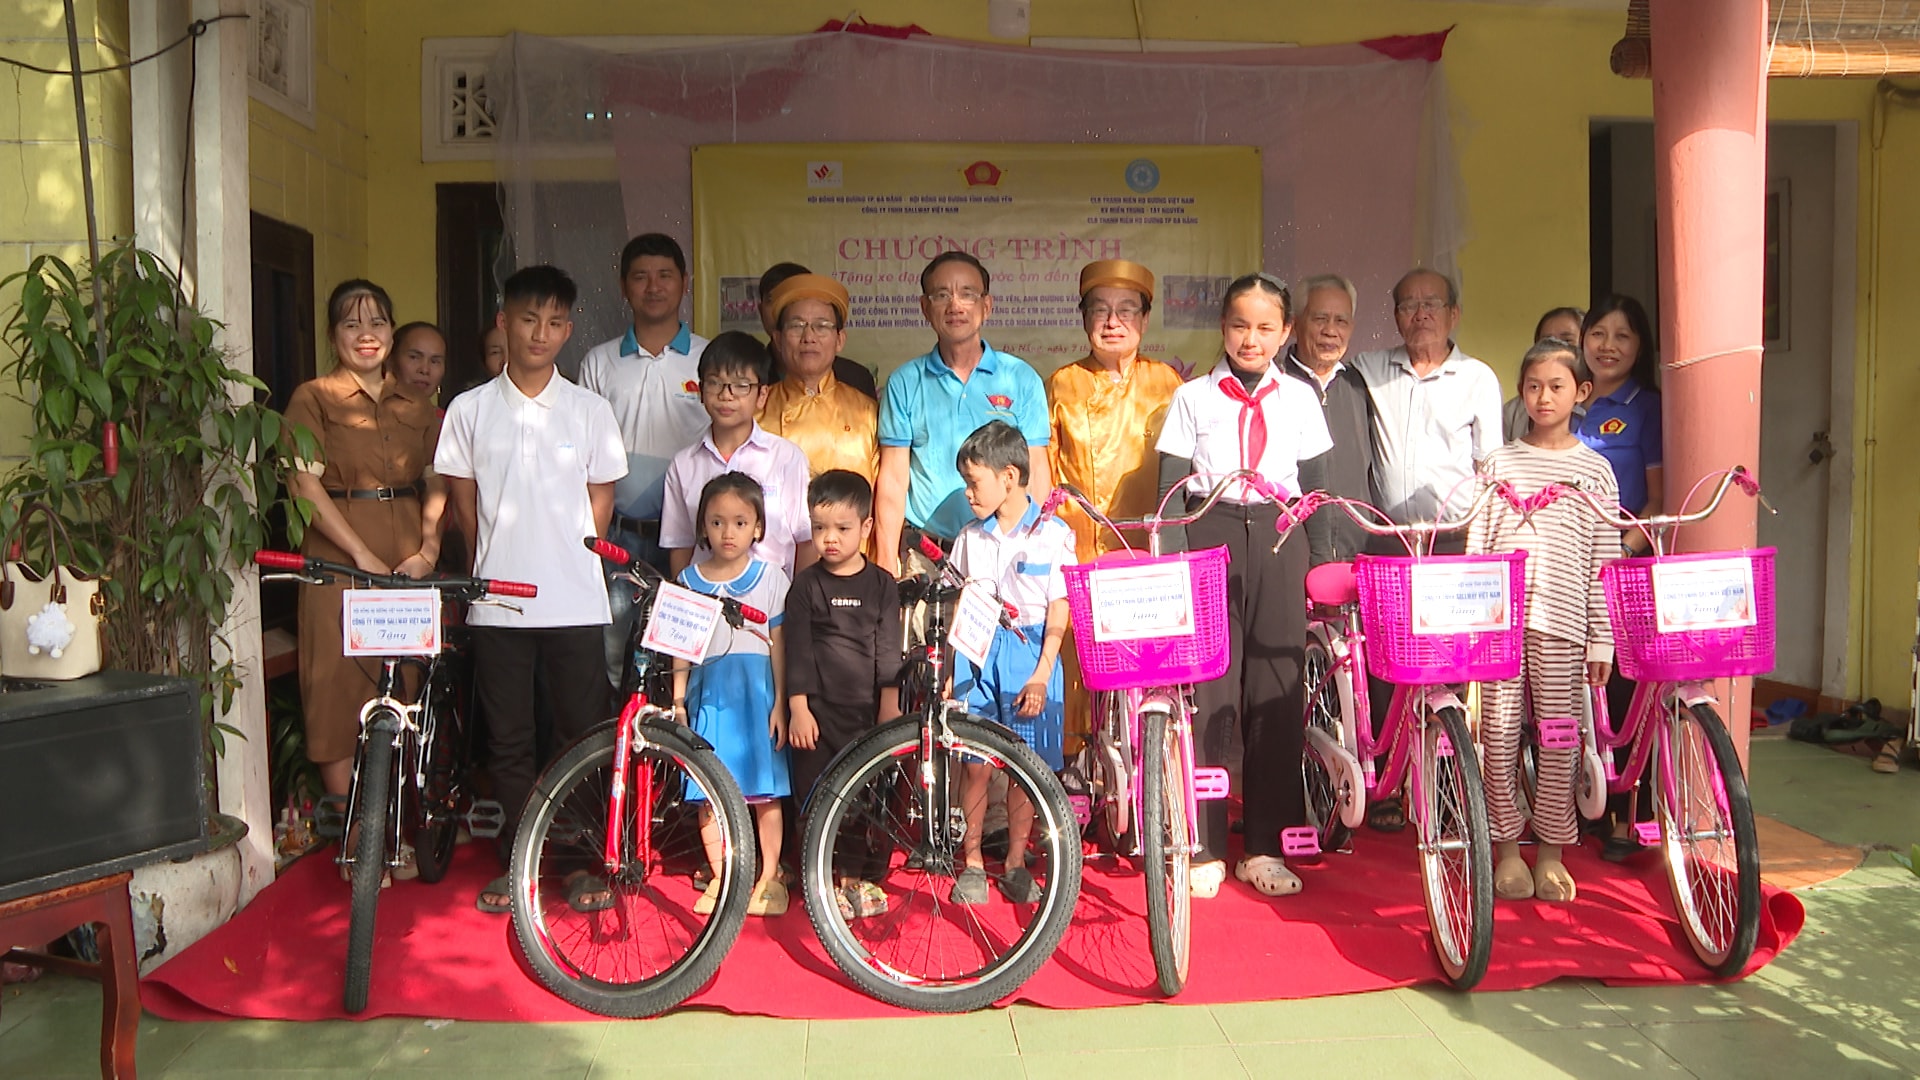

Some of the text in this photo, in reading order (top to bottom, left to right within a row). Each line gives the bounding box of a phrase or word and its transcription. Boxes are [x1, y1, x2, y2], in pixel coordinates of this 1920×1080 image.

[838, 231, 1122, 261] CHƯƠNG TRÌNH
[1019, 274, 1040, 282] em
[1044, 270, 1069, 282] đến
[906, 294, 920, 304] ĐỒN
[377, 629, 407, 640] Tặng
